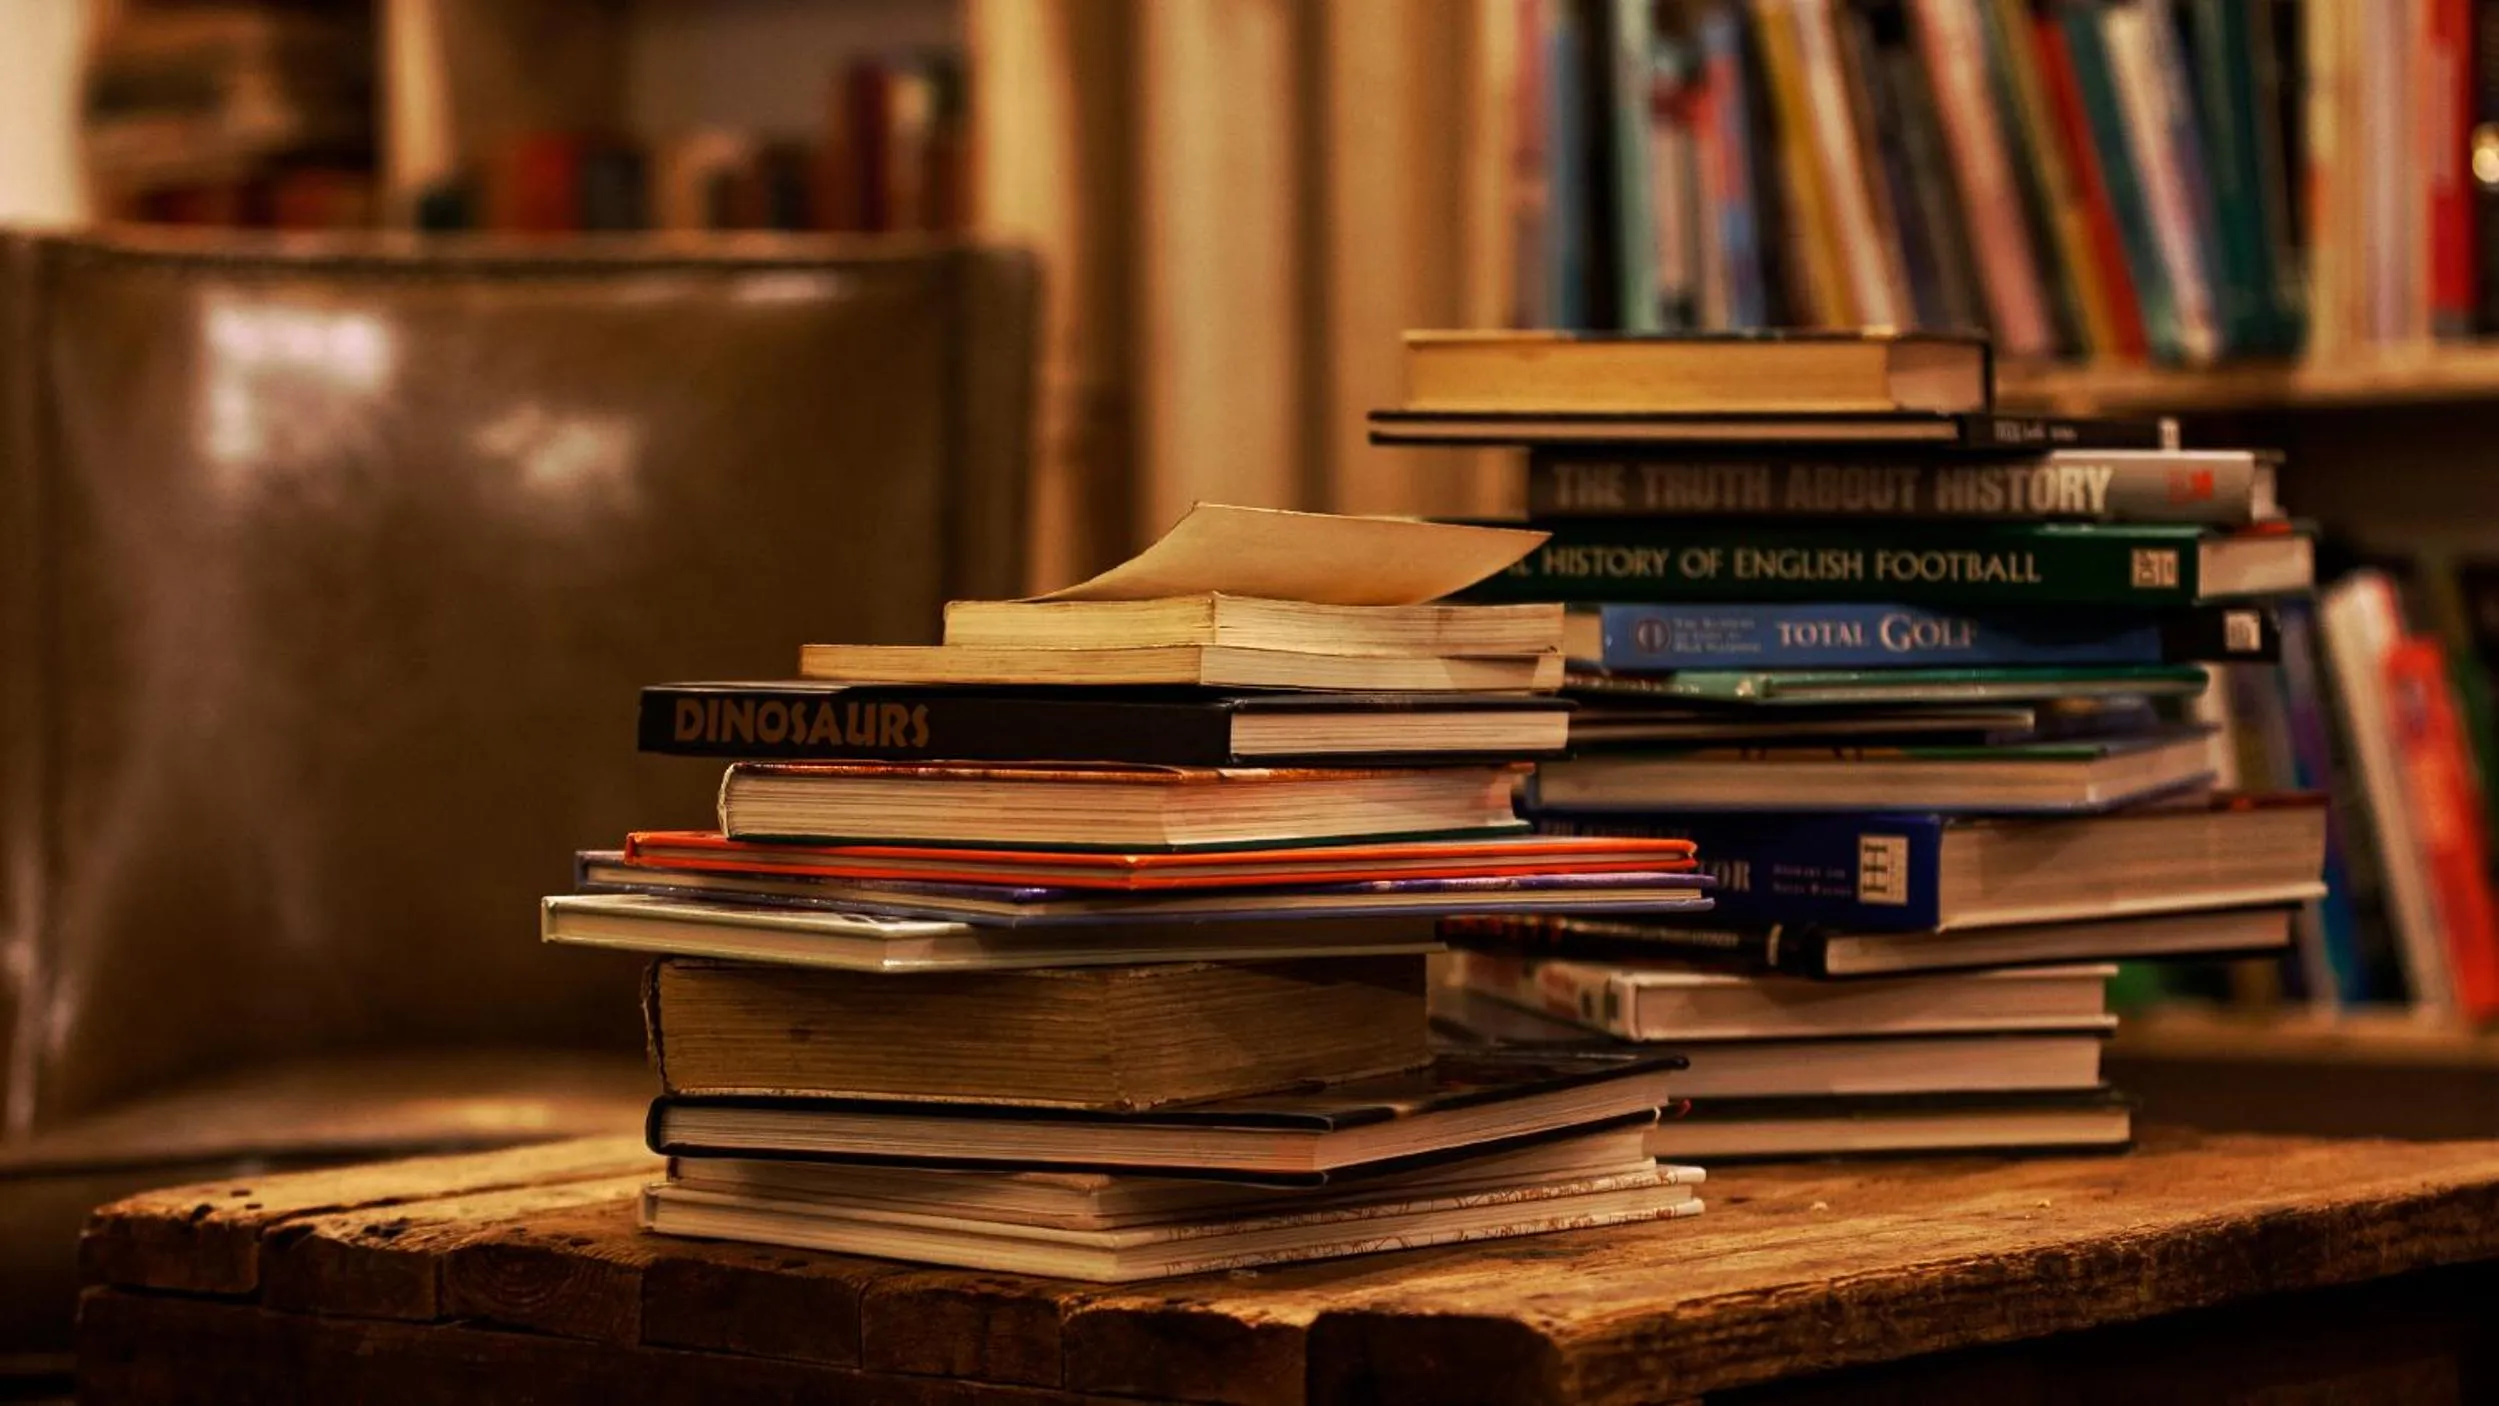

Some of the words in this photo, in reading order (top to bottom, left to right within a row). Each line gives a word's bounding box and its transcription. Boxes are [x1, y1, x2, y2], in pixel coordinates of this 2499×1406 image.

[1552, 465, 1624, 510] THE
[1640, 465, 1770, 511] TRUTH
[1786, 465, 1917, 511] ABOUT
[1936, 466, 2112, 513] HISTORY
[1542, 546, 1669, 579] HISTORY
[1681, 548, 1723, 579] OF
[1735, 549, 1863, 580] ENGLISH
[1876, 551, 2042, 583] FOOTBALL
[1776, 622, 1869, 648] TOTAL
[674, 699, 929, 748] DINOSAURS
